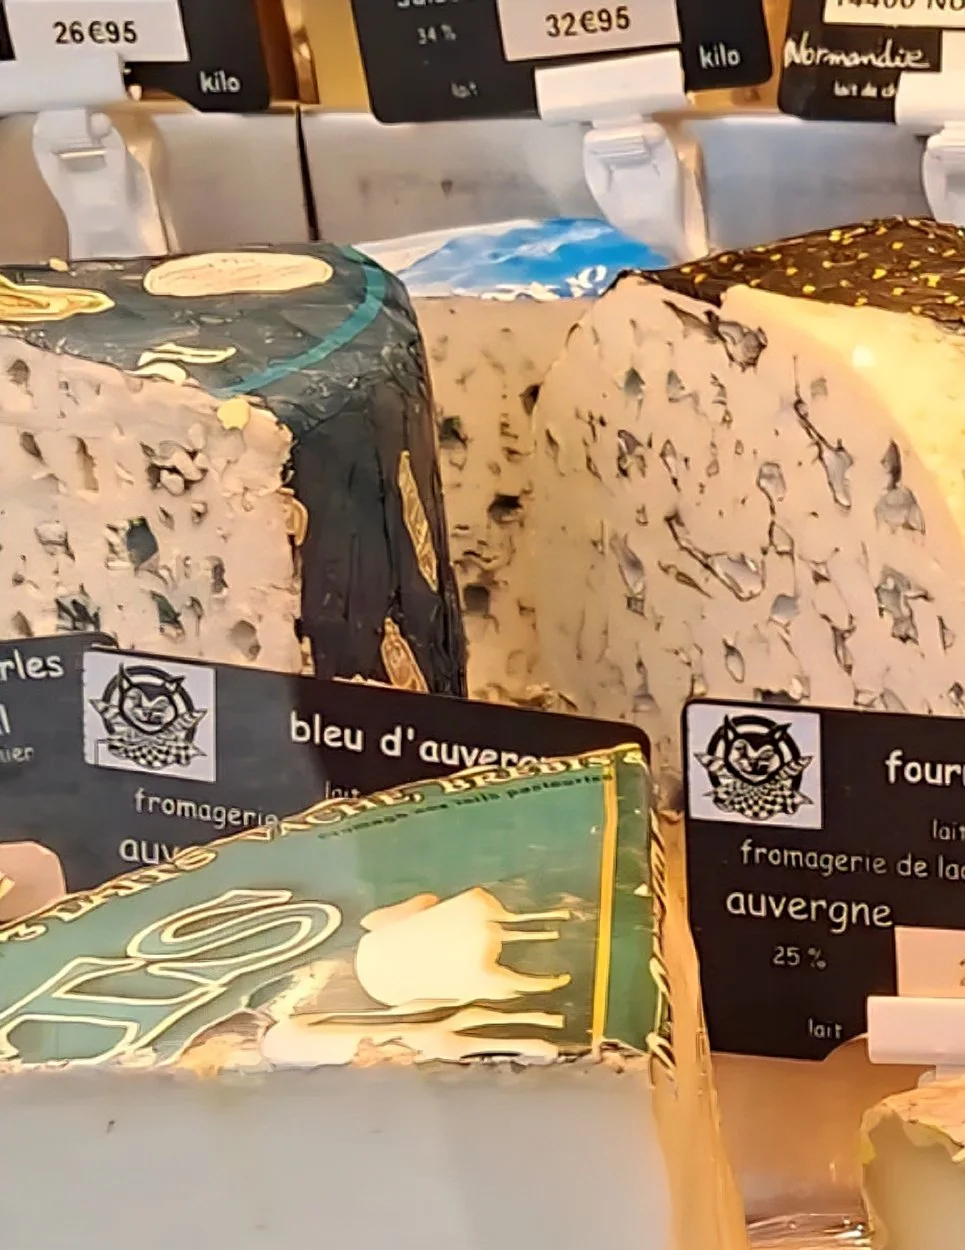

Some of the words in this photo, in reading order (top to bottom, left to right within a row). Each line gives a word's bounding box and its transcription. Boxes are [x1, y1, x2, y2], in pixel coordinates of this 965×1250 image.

[53, 20, 138, 44] 26€95
[545, 6, 631, 37] 32€95
[700, 42, 741, 69] kilo
[200, 70, 241, 93] kilo
[290, 710, 362, 752] bleu
[118, 838, 180, 866] auv
[741, 839, 887, 877] fromagerie
[896, 852, 928, 878] de
[725, 891, 893, 933] auvergne
[772, 946, 800, 967] 25
[808, 947, 827, 969] %
[807, 1018, 842, 1041] lait
